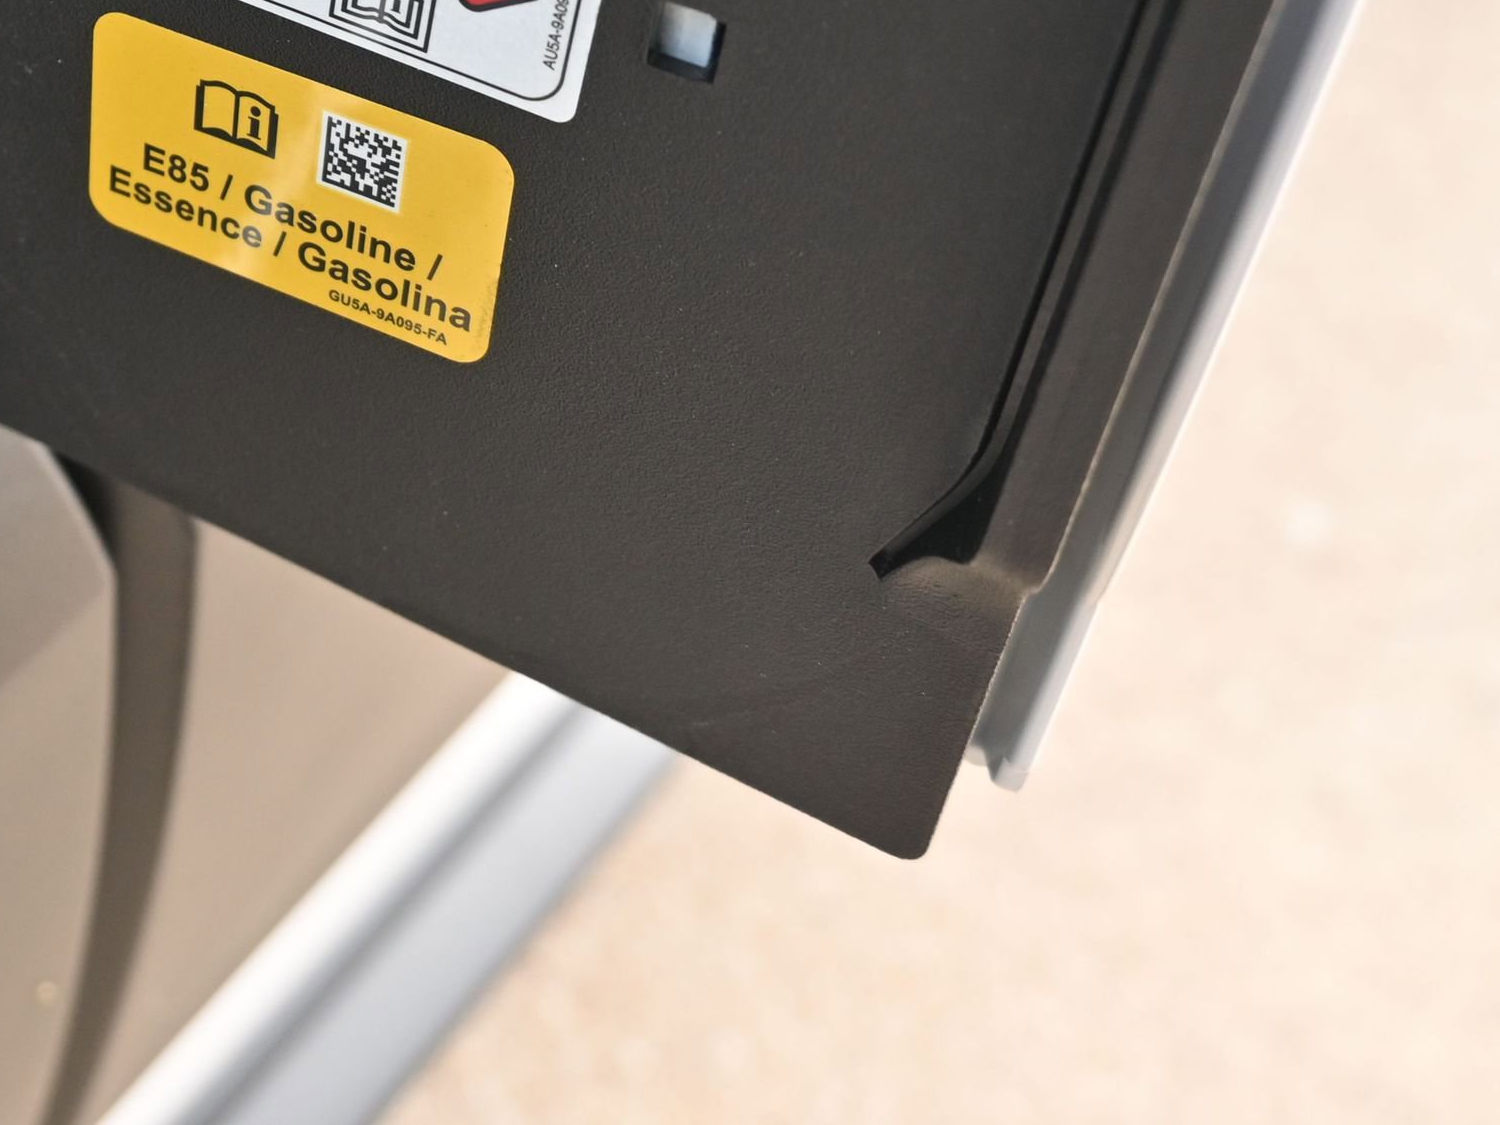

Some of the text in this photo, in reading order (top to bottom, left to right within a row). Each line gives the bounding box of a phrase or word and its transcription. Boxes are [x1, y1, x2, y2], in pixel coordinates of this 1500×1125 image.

[109, 165, 472, 332] Essence / Gasolina
[143, 142, 443, 281] E85 / Gasoline /
[328, 289, 448, 346] GU5A-9A095-FA
